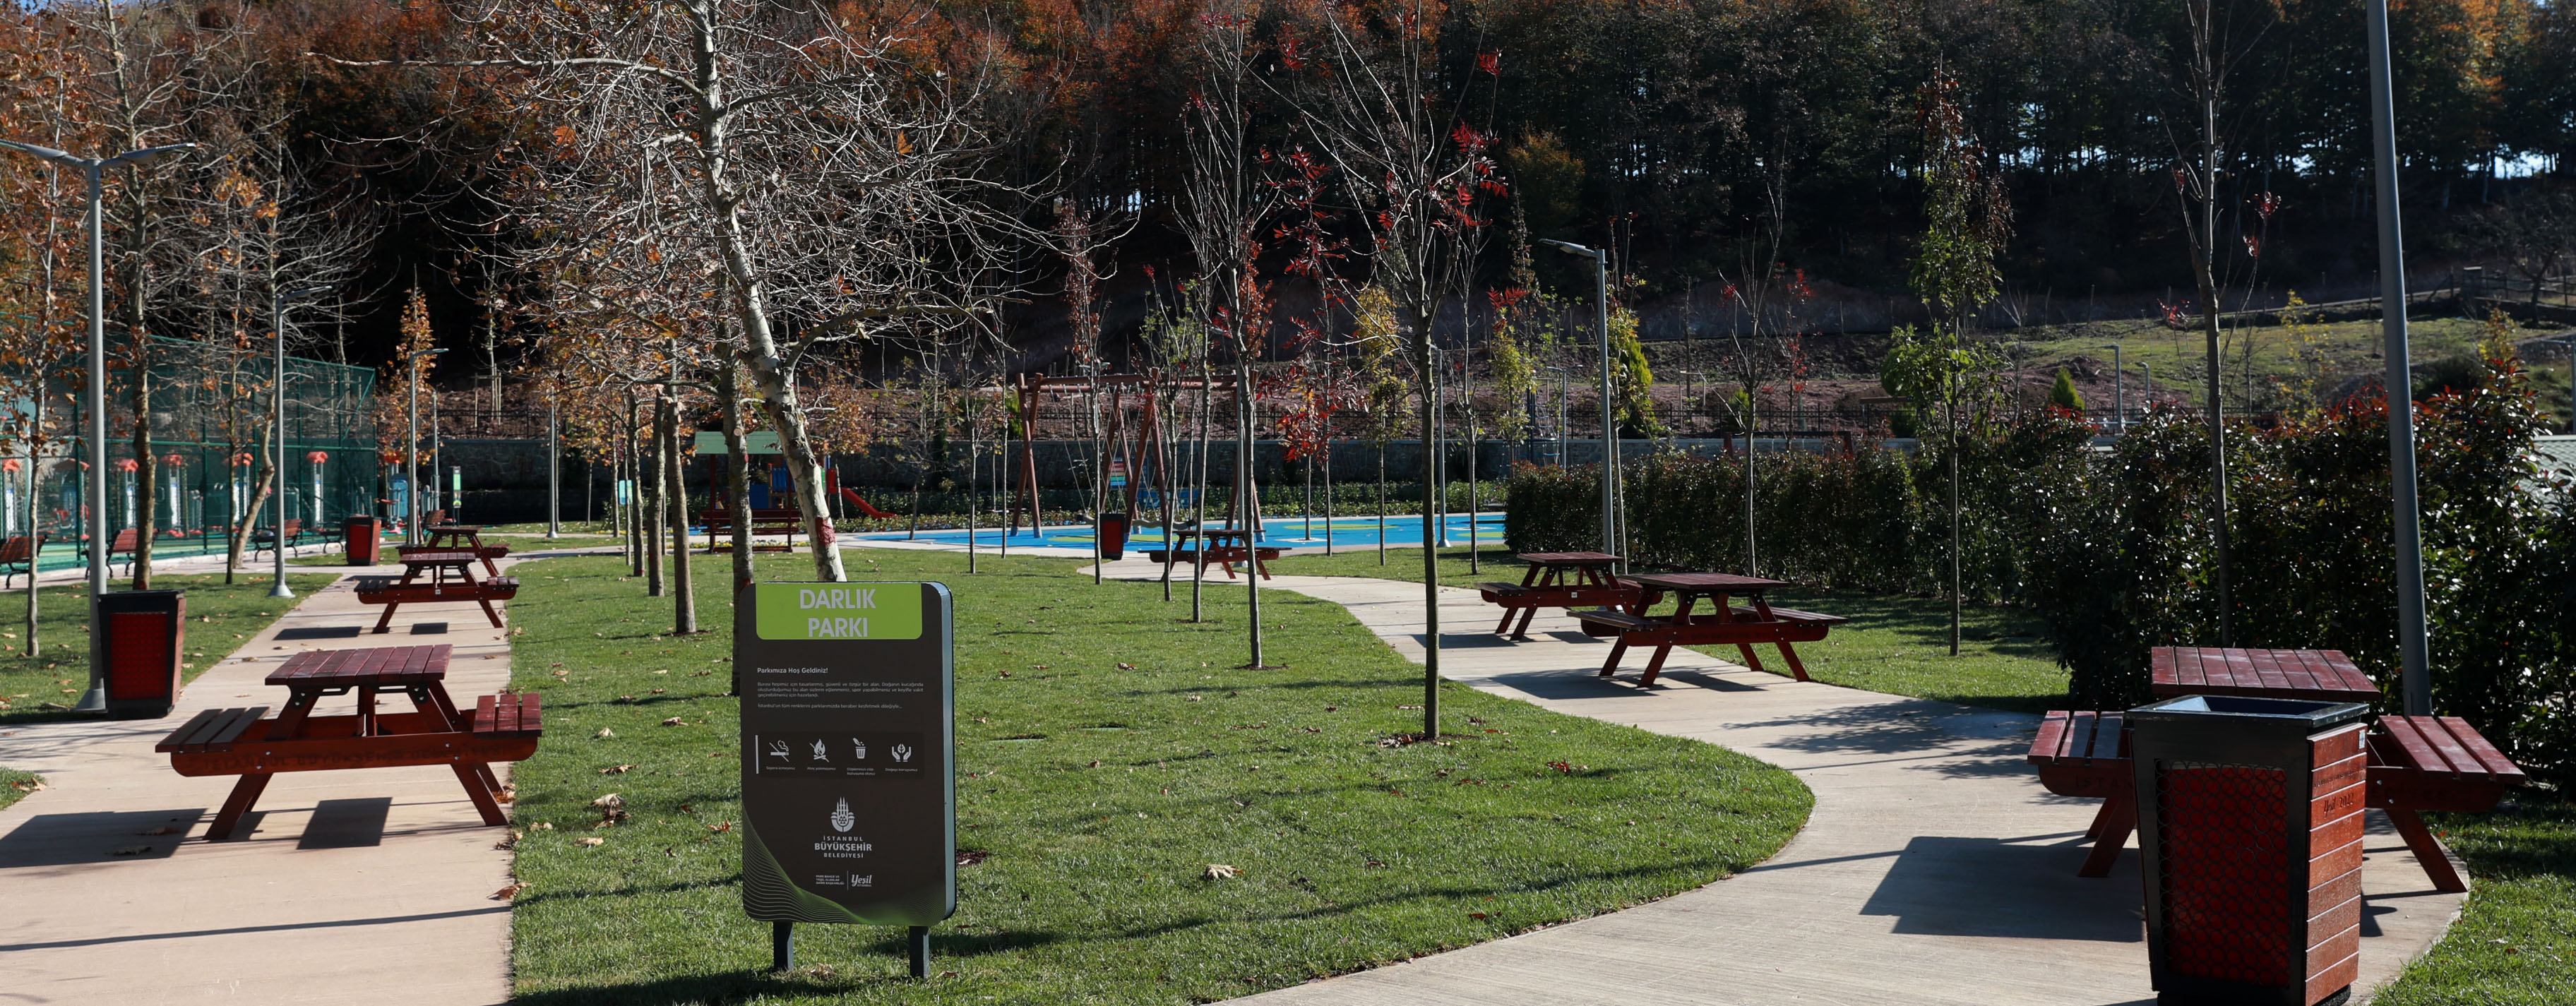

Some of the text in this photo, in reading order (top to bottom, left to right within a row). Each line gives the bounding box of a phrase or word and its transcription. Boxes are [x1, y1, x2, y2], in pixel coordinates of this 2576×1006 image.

[799, 589, 876, 609] DARLIK
[808, 618, 868, 637] PARKI
[814, 842, 872, 851] BÜYÜKŞEHİR
[851, 874, 872, 887] Yeşil
